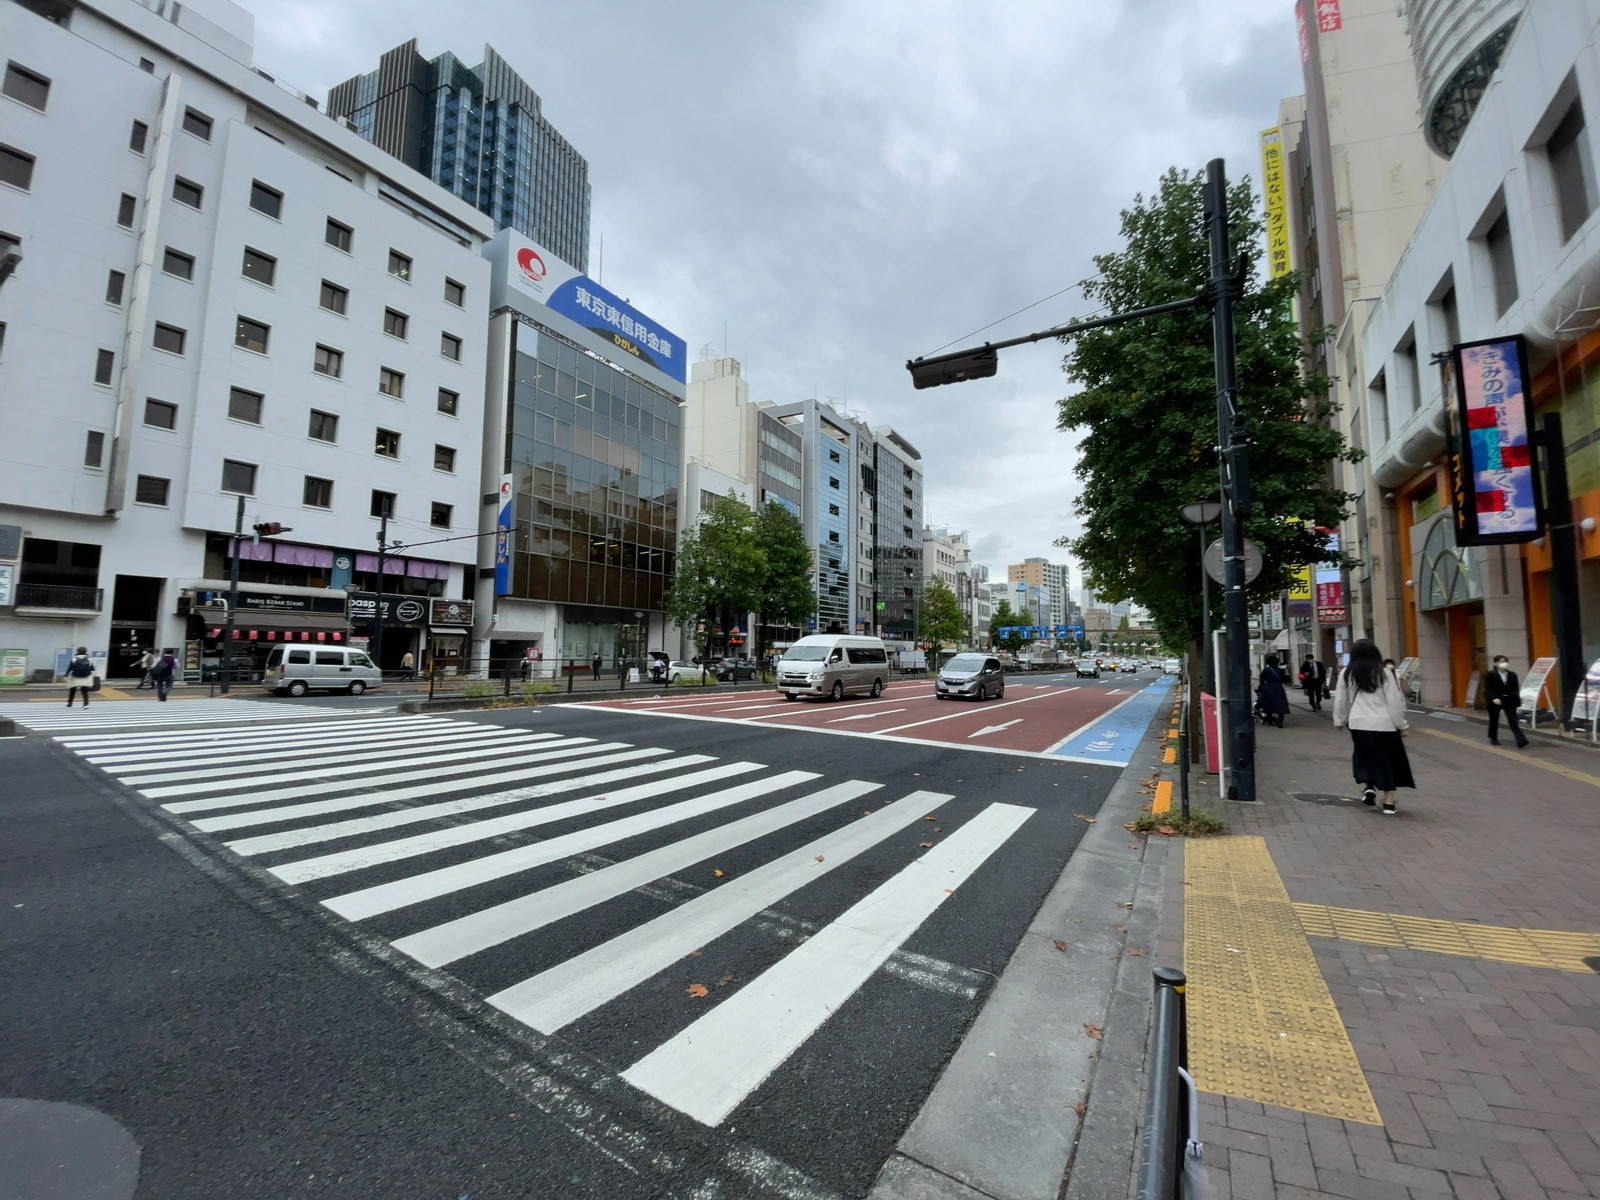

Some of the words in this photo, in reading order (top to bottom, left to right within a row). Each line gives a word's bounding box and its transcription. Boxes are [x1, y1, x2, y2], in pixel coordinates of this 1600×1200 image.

[1318, 0, 1340, 30] 飯店
[575, 285, 672, 359] 東京東信用金庫
[614, 333, 640, 356] ひがしん
[497, 525, 506, 563] ひがしん
